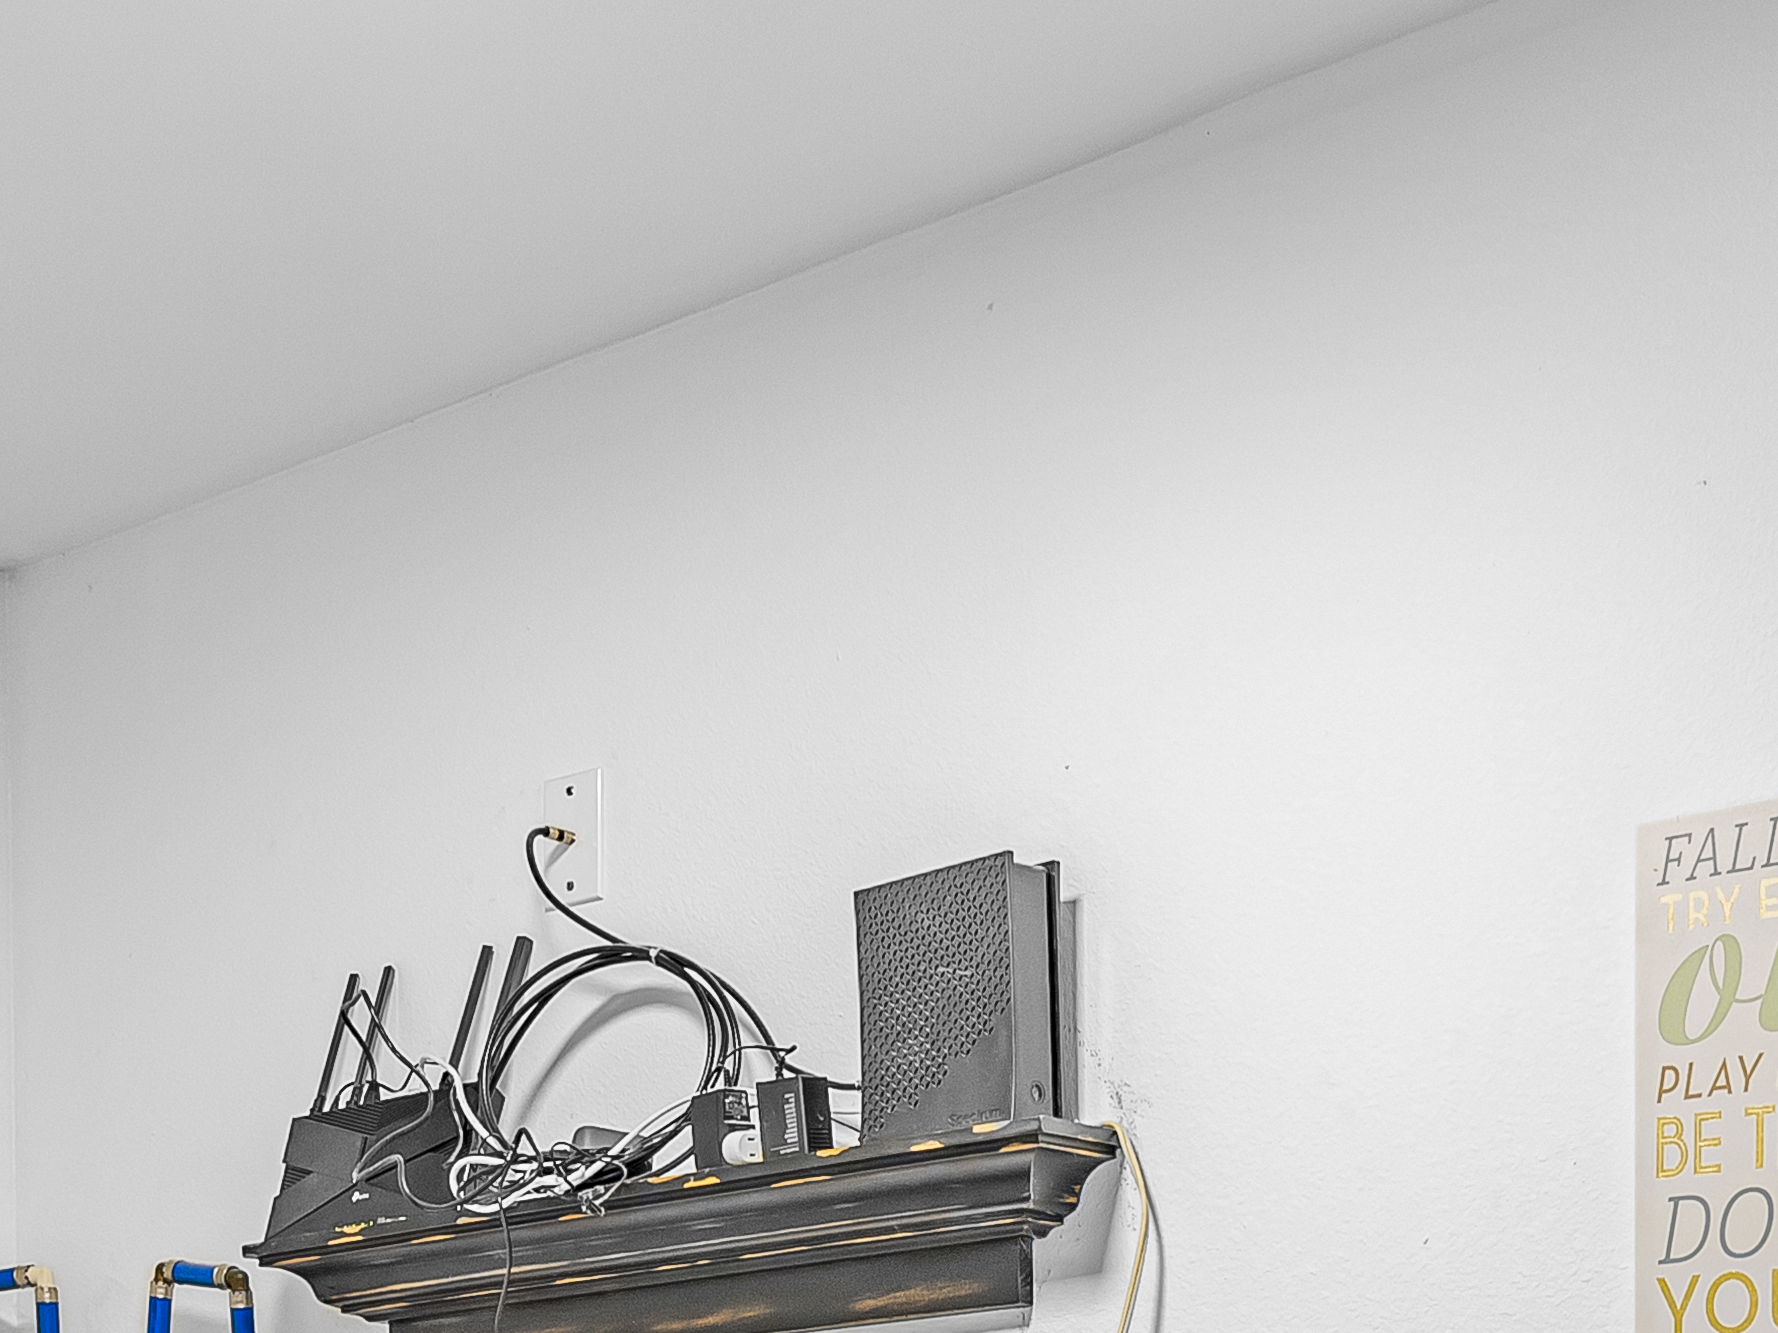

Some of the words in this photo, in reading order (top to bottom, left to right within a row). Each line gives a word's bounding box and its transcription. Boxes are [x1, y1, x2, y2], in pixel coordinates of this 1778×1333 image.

[1658, 883, 1742, 934] TRY
[1656, 1052, 1765, 1104] PLAY
[1656, 1110, 1723, 1179] BE
[1658, 1186, 1775, 1265] DO
